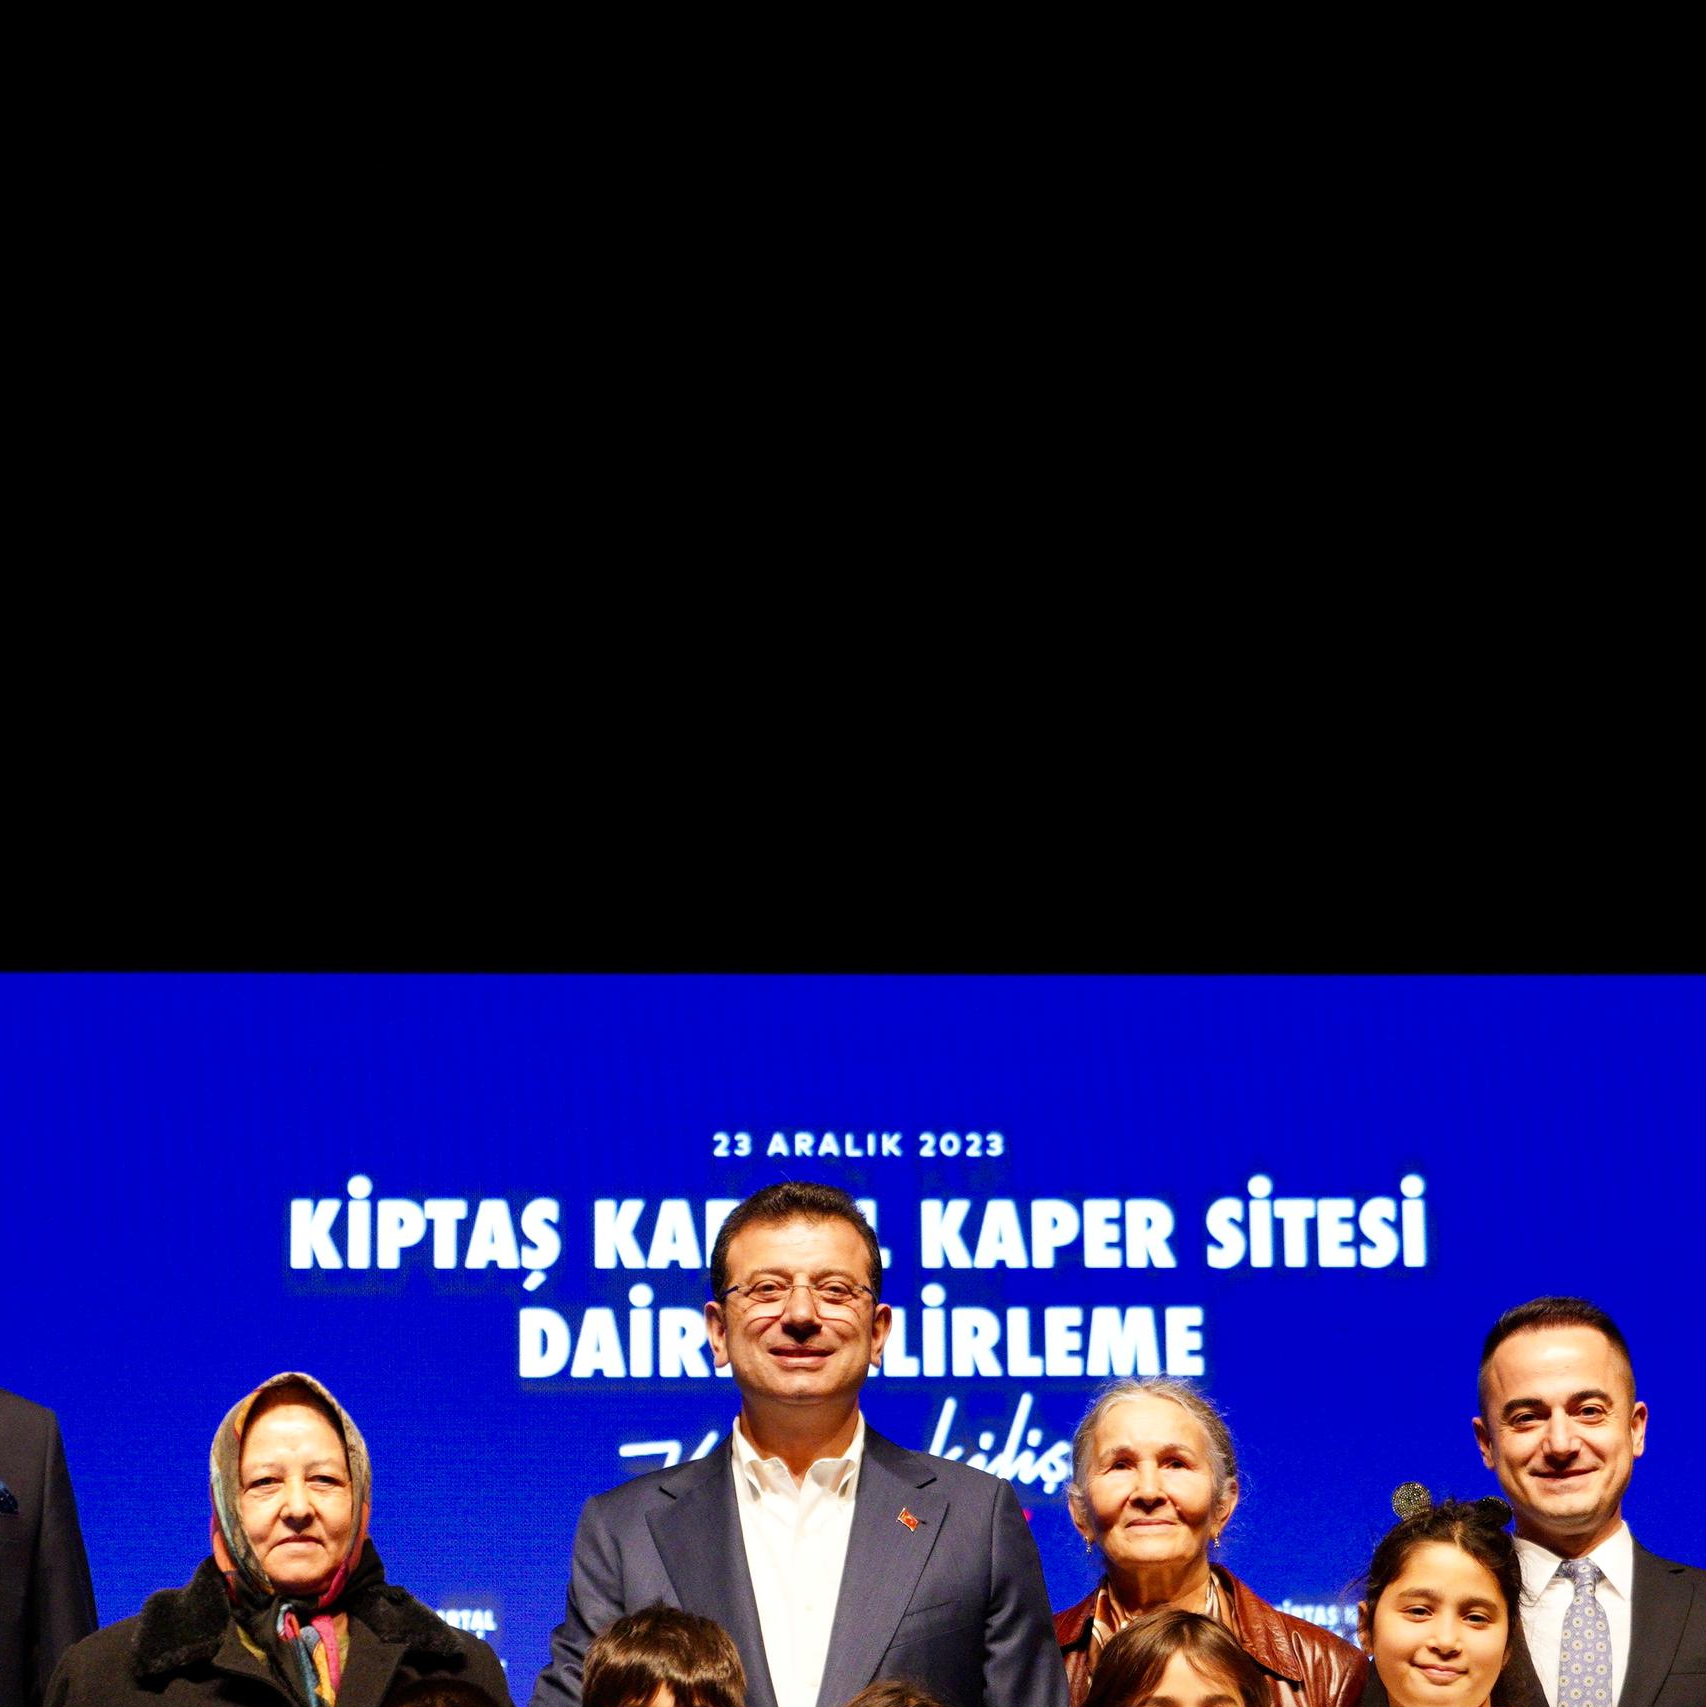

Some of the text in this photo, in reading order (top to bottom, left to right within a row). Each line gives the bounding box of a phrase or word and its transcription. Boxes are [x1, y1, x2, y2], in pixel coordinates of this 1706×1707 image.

[712, 1131, 1006, 1158] 23 ARALIK 2023
[289, 1174, 563, 1292] KİPTAŞ
[919, 1197, 1178, 1270] KAPER
[1204, 1173, 1428, 1271] SİTESİ
[518, 1282, 1206, 1379] DAİR LİRLEME
